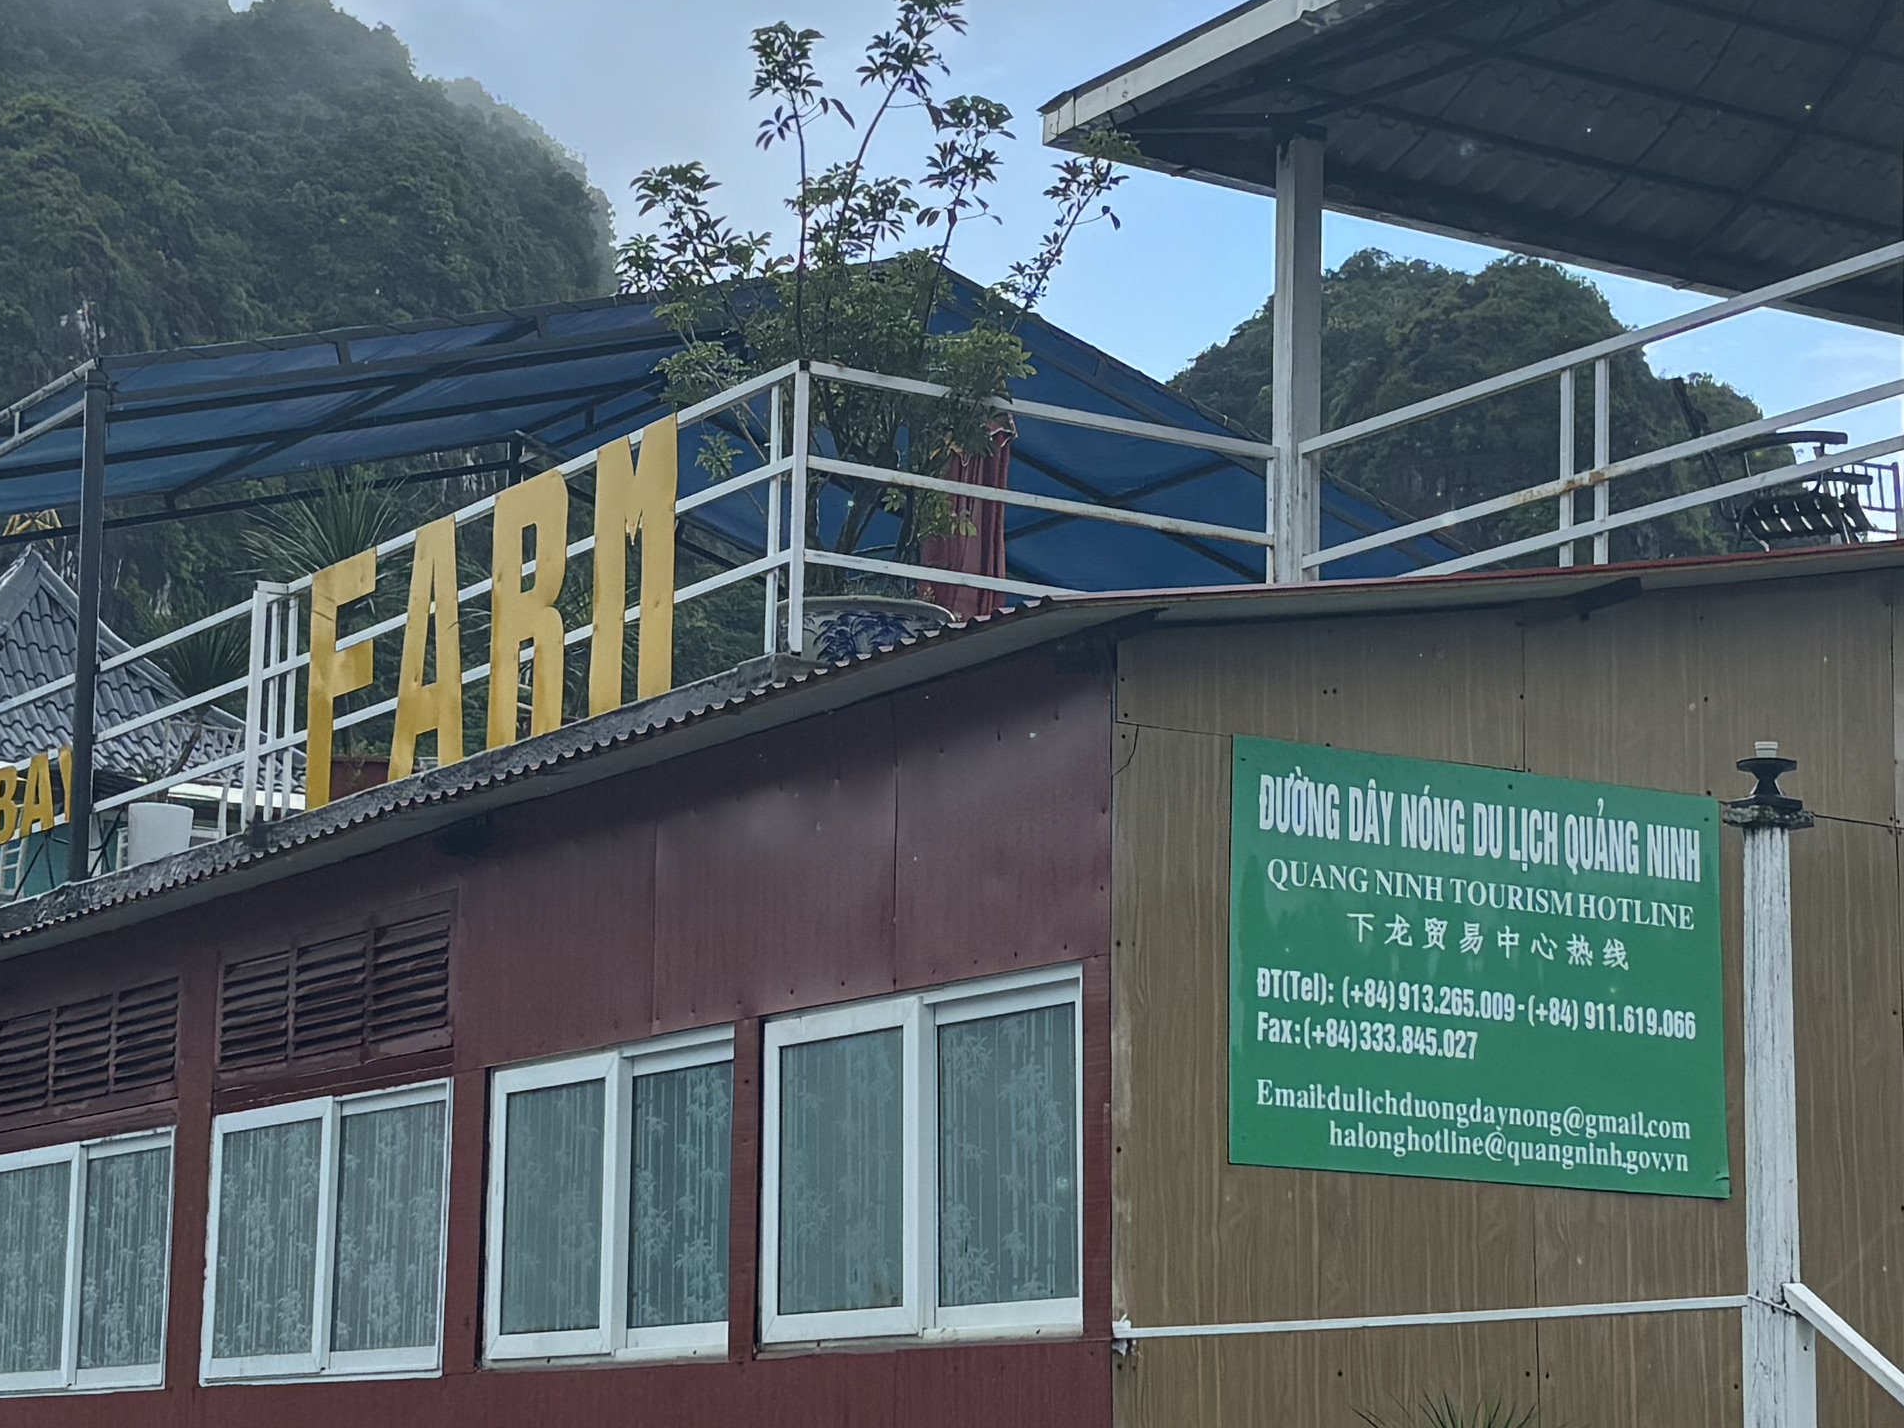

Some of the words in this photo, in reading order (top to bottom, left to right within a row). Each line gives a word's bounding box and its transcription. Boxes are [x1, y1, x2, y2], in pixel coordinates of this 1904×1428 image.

[305, 412, 678, 812] FARM
[1259, 766, 1340, 840] ĐƯỜNG
[1349, 778, 1394, 846] DÂY
[1401, 784, 1465, 854] NÓNG
[1474, 802, 1503, 859] DU
[1509, 806, 1558, 872] LỊCH
[1565, 797, 1639, 875] QUẢNG
[1647, 824, 1701, 883] NINH
[1267, 858, 1368, 894] QUANG
[1375, 871, 1443, 902] NINH
[1450, 878, 1572, 917] TOURISM
[1579, 893, 1695, 930] HOTLINE
[1584, 1001, 1696, 1040] 911.619.066
